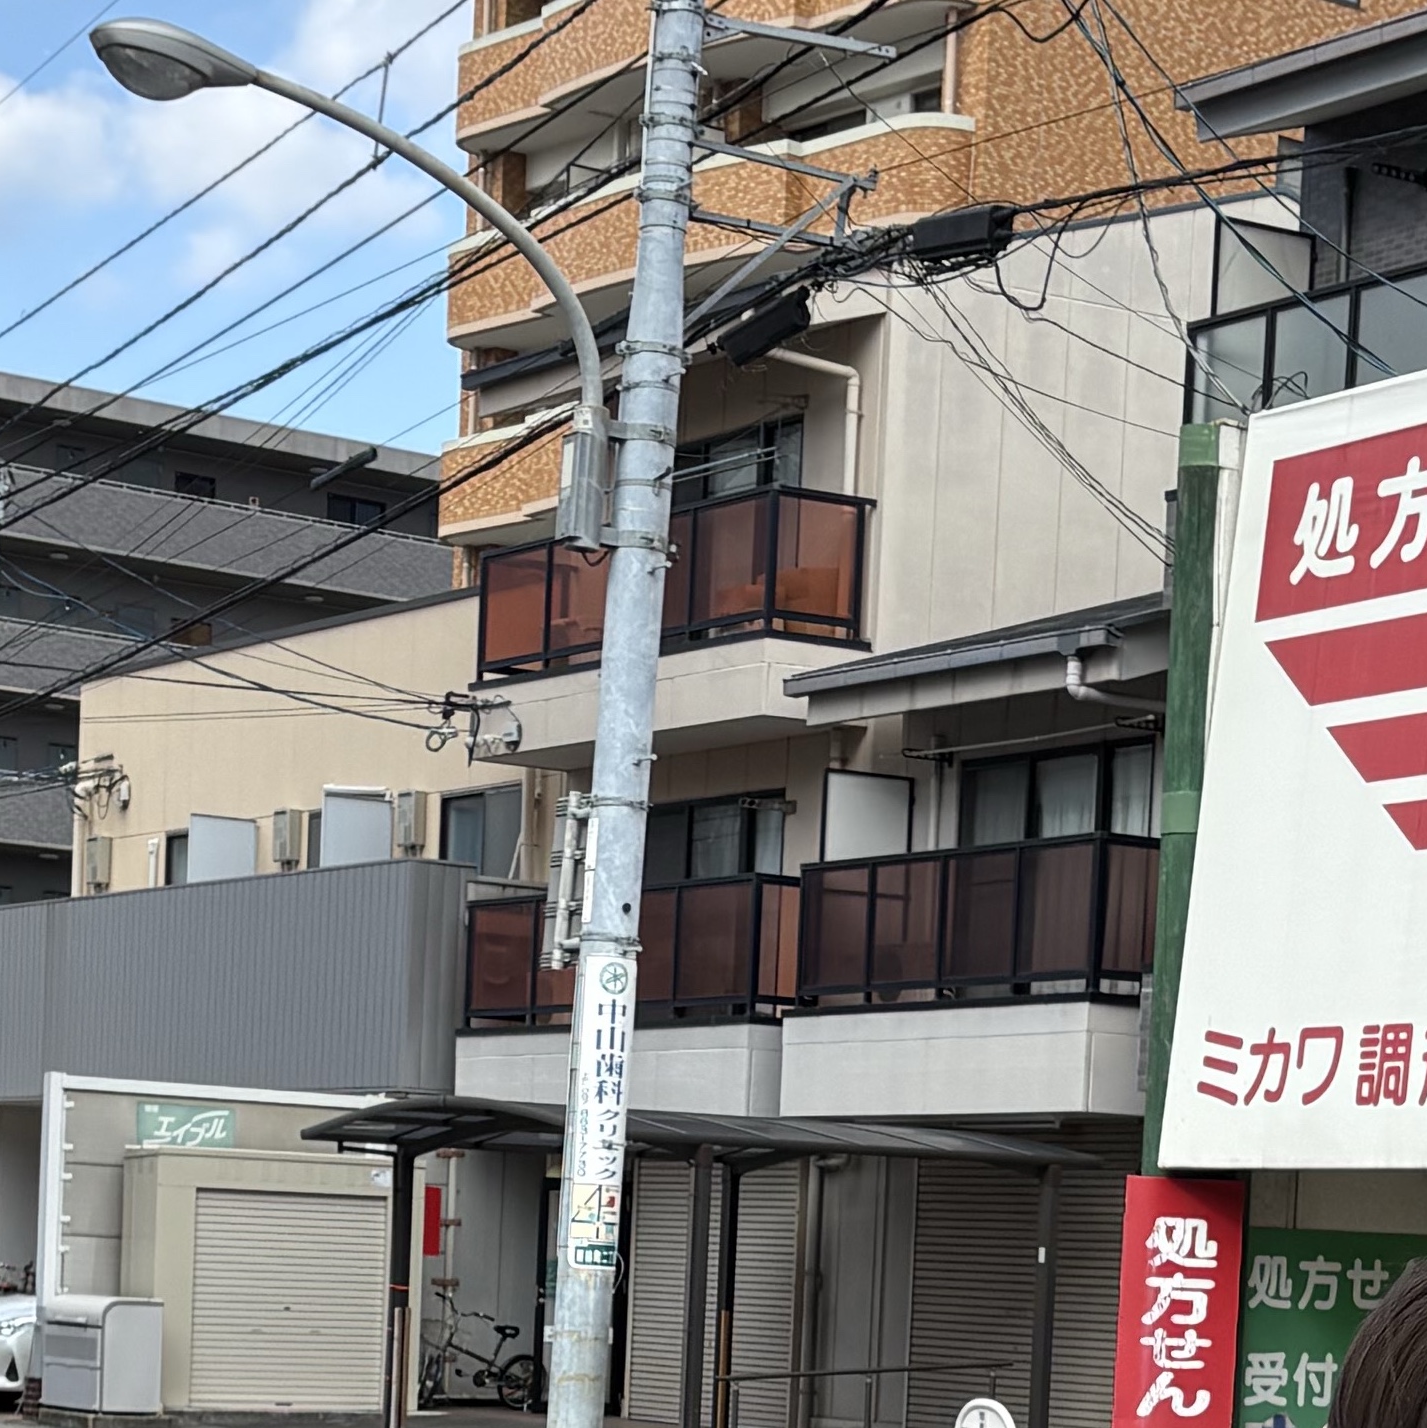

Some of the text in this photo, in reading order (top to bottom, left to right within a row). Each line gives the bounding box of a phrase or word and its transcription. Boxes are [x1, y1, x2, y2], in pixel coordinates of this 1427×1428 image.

[142, 1110, 230, 1149] エイブル
[1135, 1216, 1219, 1418] 処方せん
[1243, 1351, 1339, 1408] 受付
